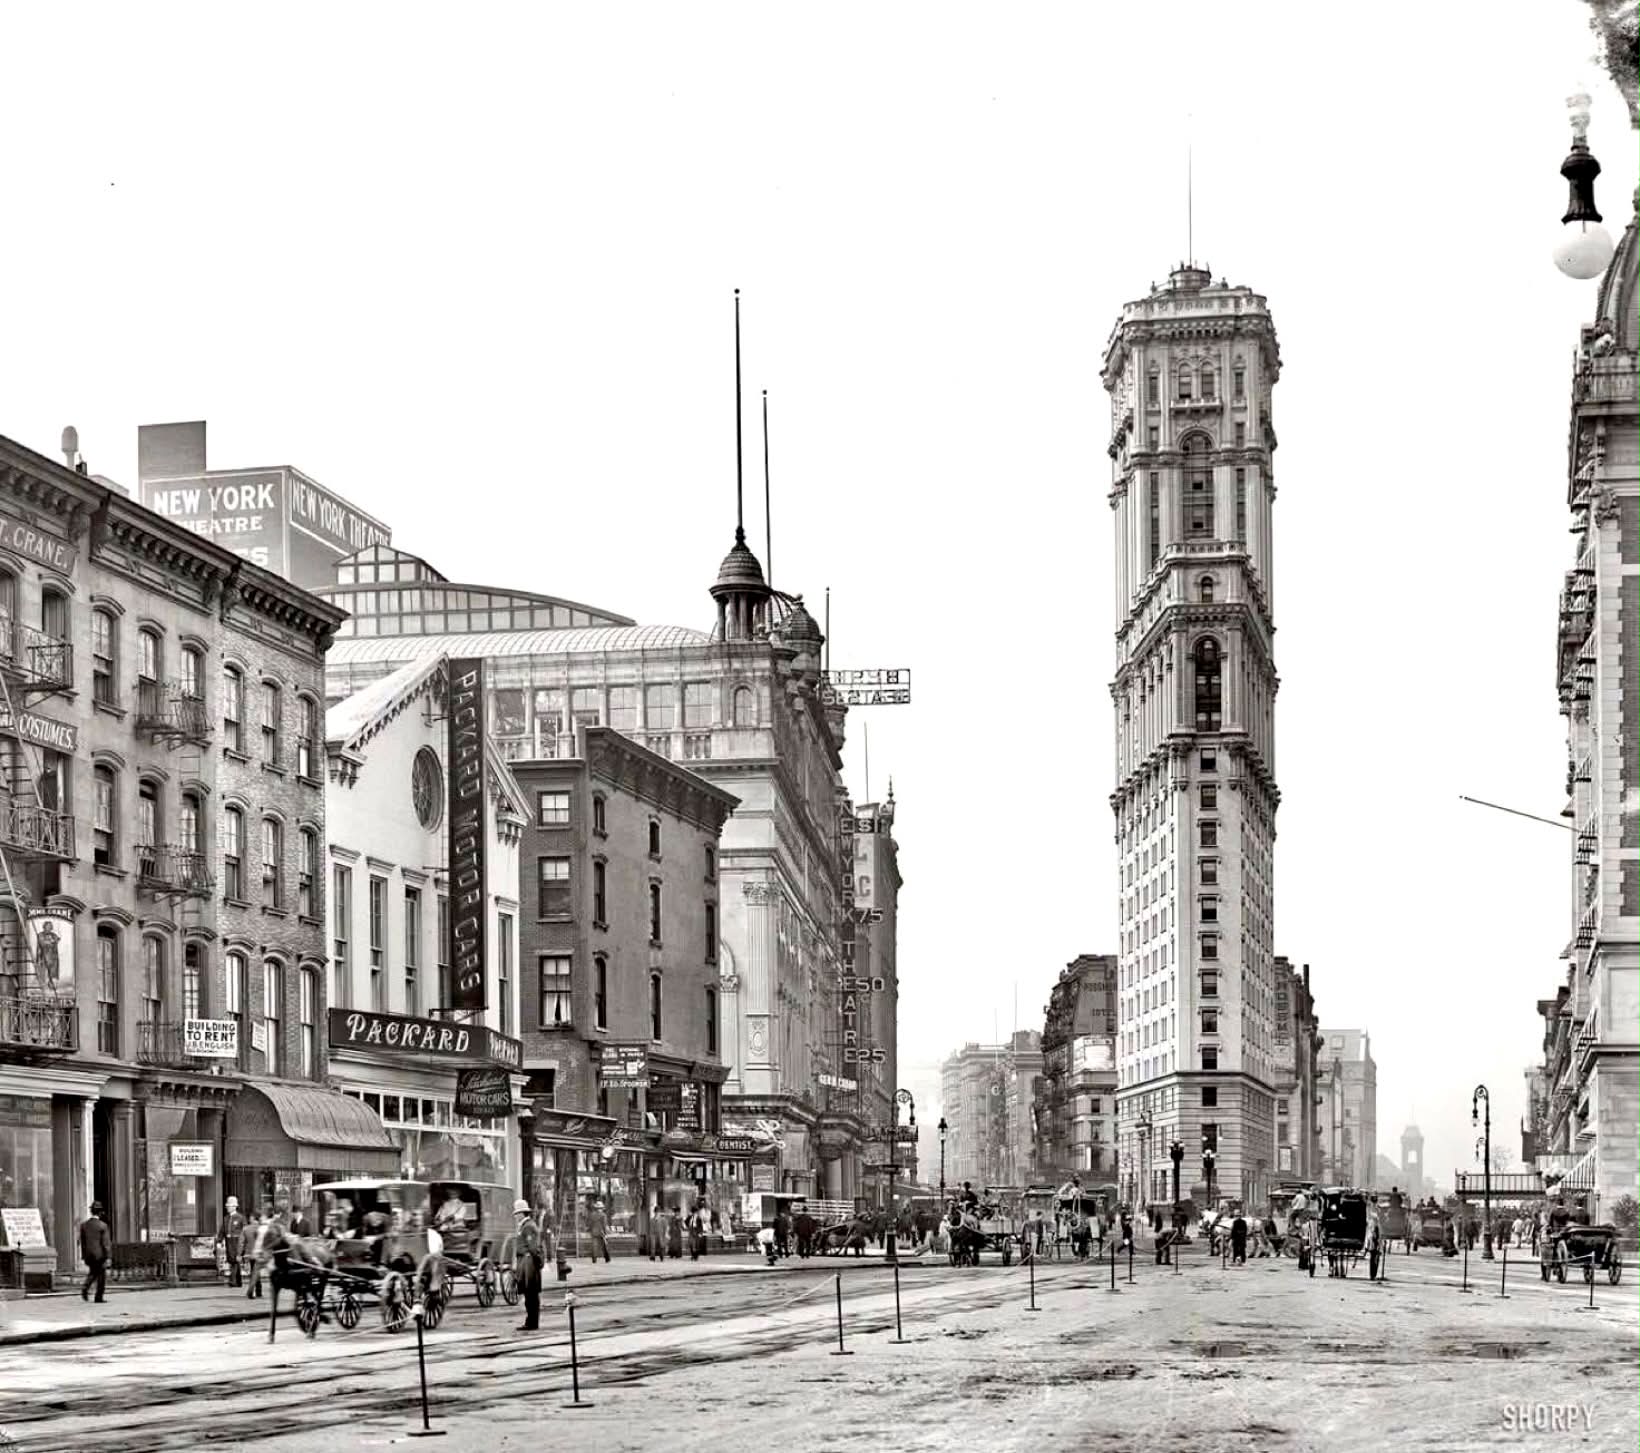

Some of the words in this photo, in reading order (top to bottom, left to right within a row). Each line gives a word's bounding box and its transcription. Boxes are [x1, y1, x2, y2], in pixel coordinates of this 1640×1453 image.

[154, 488, 201, 515] NEW
[208, 483, 275, 512] YORK
[293, 478, 317, 522] NEW
[318, 493, 346, 541] YORK
[178, 516, 264, 534] HEATRE
[13, 526, 68, 569] CRANE.
[20, 713, 73, 749] COSTUMES.
[453, 668, 481, 800] PACKARD
[456, 806, 481, 911] MOTOR
[841, 855, 856, 922] YORK
[860, 907, 883, 923] 75
[454, 915, 482, 993] CARS
[842, 940, 857, 1064] THEATRE
[856, 976, 885, 992] 50
[186, 1030, 202, 1041] TO
[204, 1031, 236, 1042] RENT
[187, 1020, 236, 1032] BUILDING
[346, 1012, 471, 1054] PACKARD
[858, 1049, 886, 1064] 25
[718, 1139, 753, 1151] DENTIST
